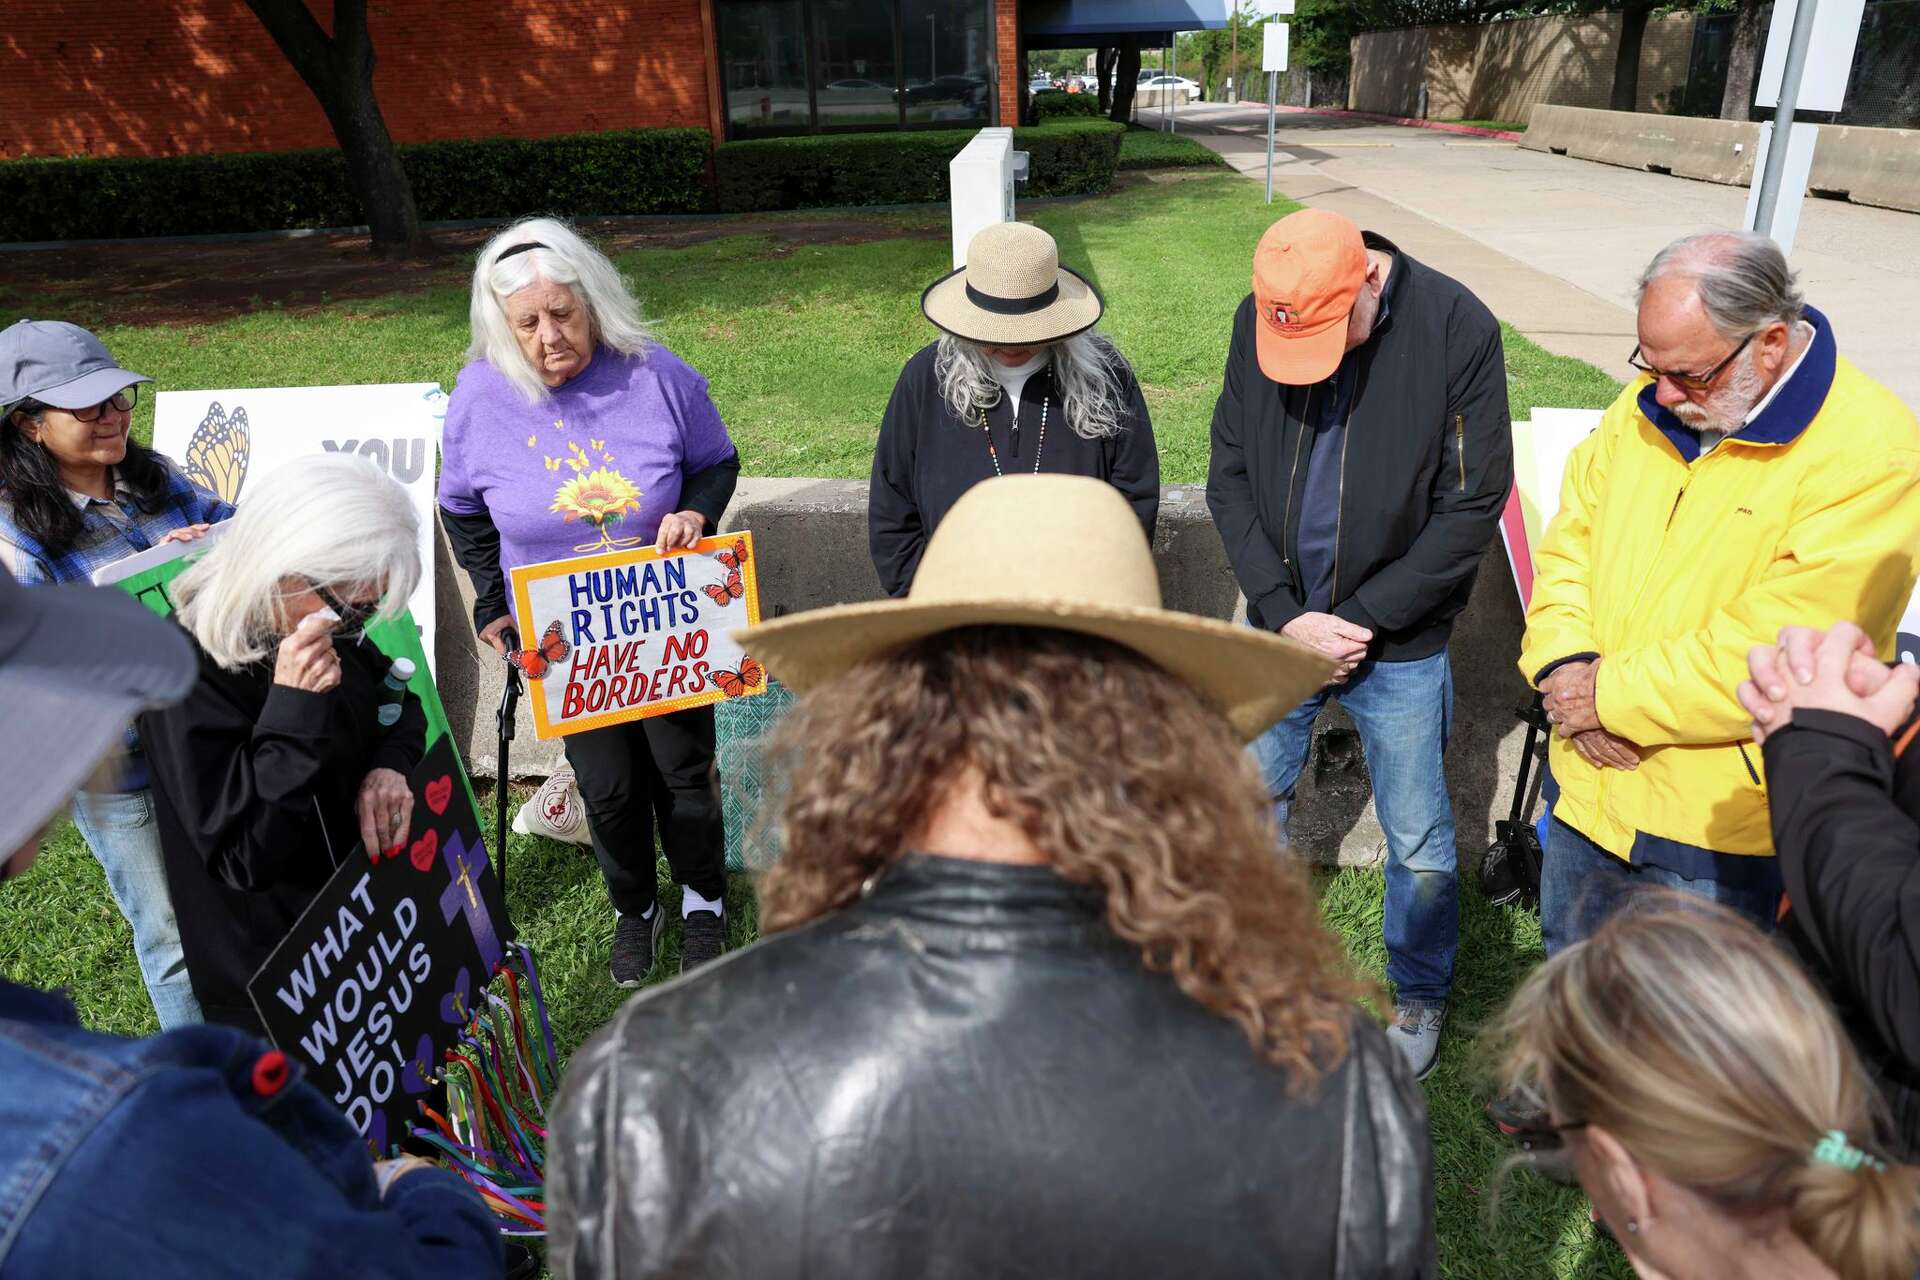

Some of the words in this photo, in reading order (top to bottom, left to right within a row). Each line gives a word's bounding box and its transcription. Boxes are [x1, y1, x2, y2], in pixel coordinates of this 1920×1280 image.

[568, 557, 687, 607] HUMAN
[571, 590, 700, 646] RIGHTS
[561, 660, 710, 719] BORDERS
[569, 639, 646, 682] HAVE
[662, 628, 709, 666] NO
[276, 872, 376, 1016] WHAT
[300, 897, 418, 1065] WOULD
[335, 942, 432, 1104] JESUS
[345, 1040, 406, 1137] DO!
